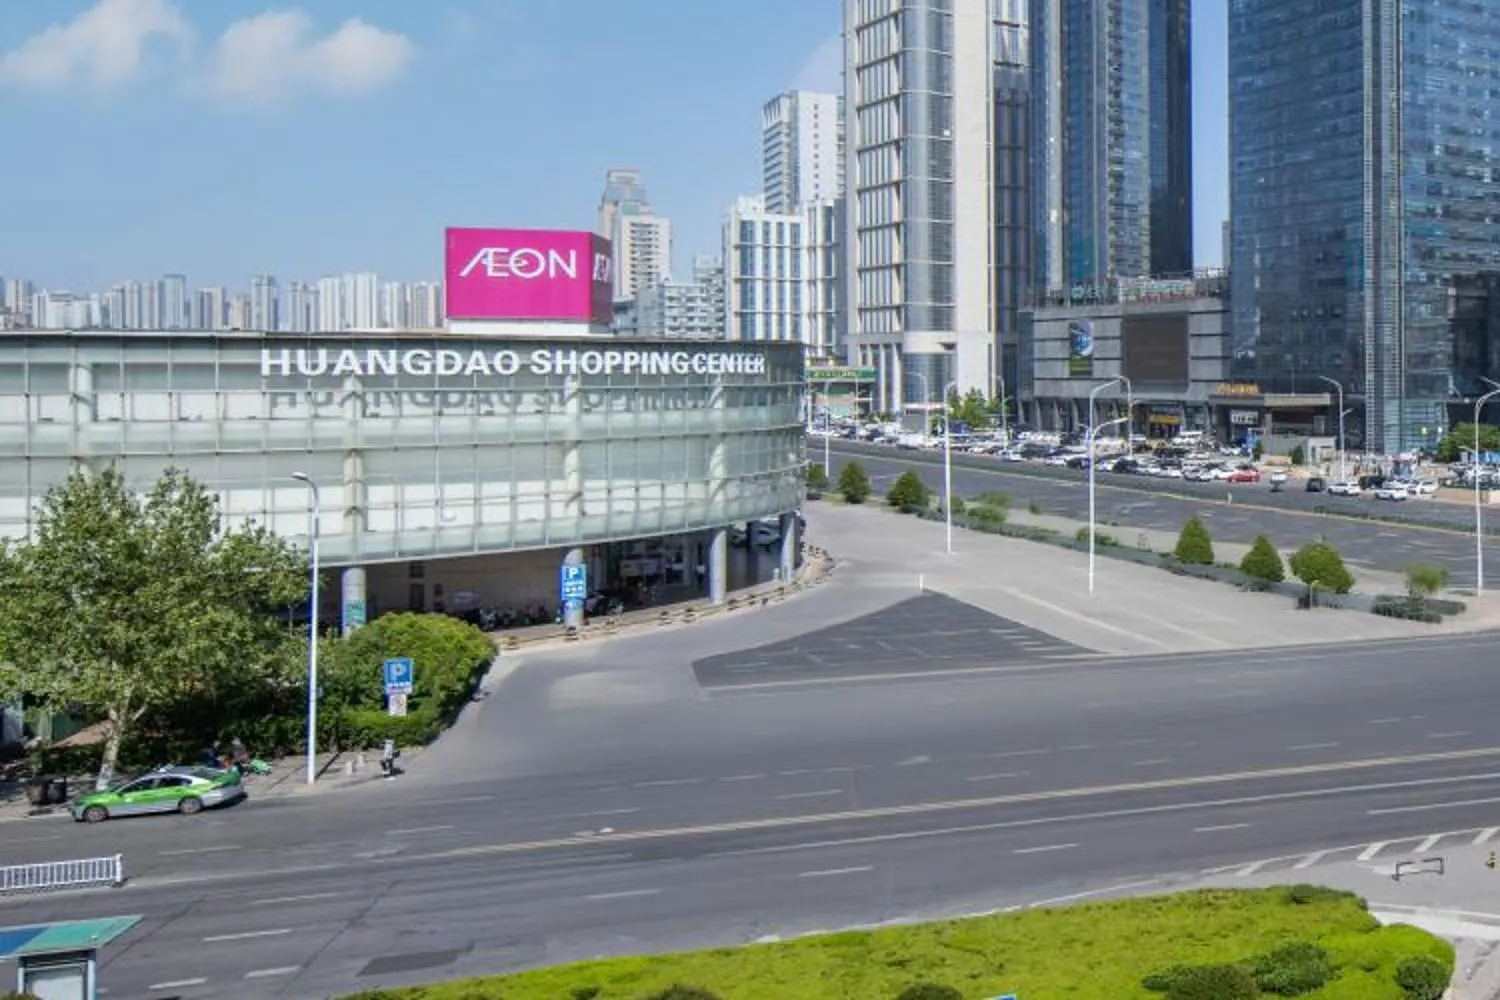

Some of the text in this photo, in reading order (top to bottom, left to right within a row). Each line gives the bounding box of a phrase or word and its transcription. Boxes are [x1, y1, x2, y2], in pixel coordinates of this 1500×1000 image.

[260, 348, 766, 377] HUANGDAO SHOPPING CENTER
[390, 663, 406, 681] P
